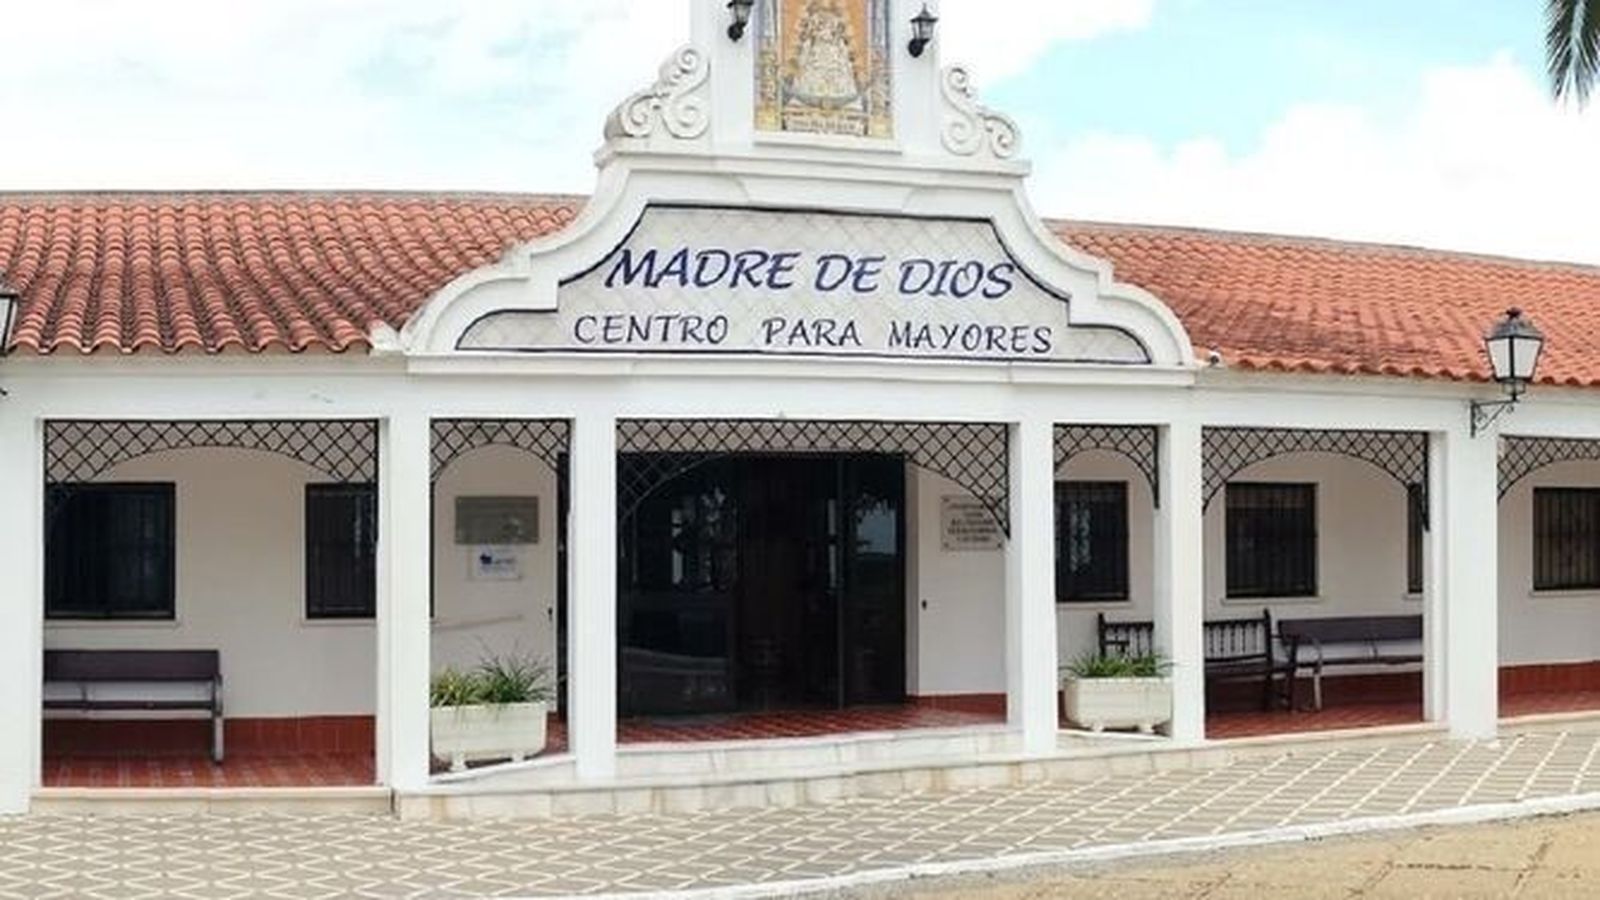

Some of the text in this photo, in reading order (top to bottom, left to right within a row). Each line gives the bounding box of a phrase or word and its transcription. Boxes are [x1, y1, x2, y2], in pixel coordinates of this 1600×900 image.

[604, 248, 1016, 299] MADRE DE DIOS
[574, 313, 1053, 354] CENTRO PARA MAYORES
